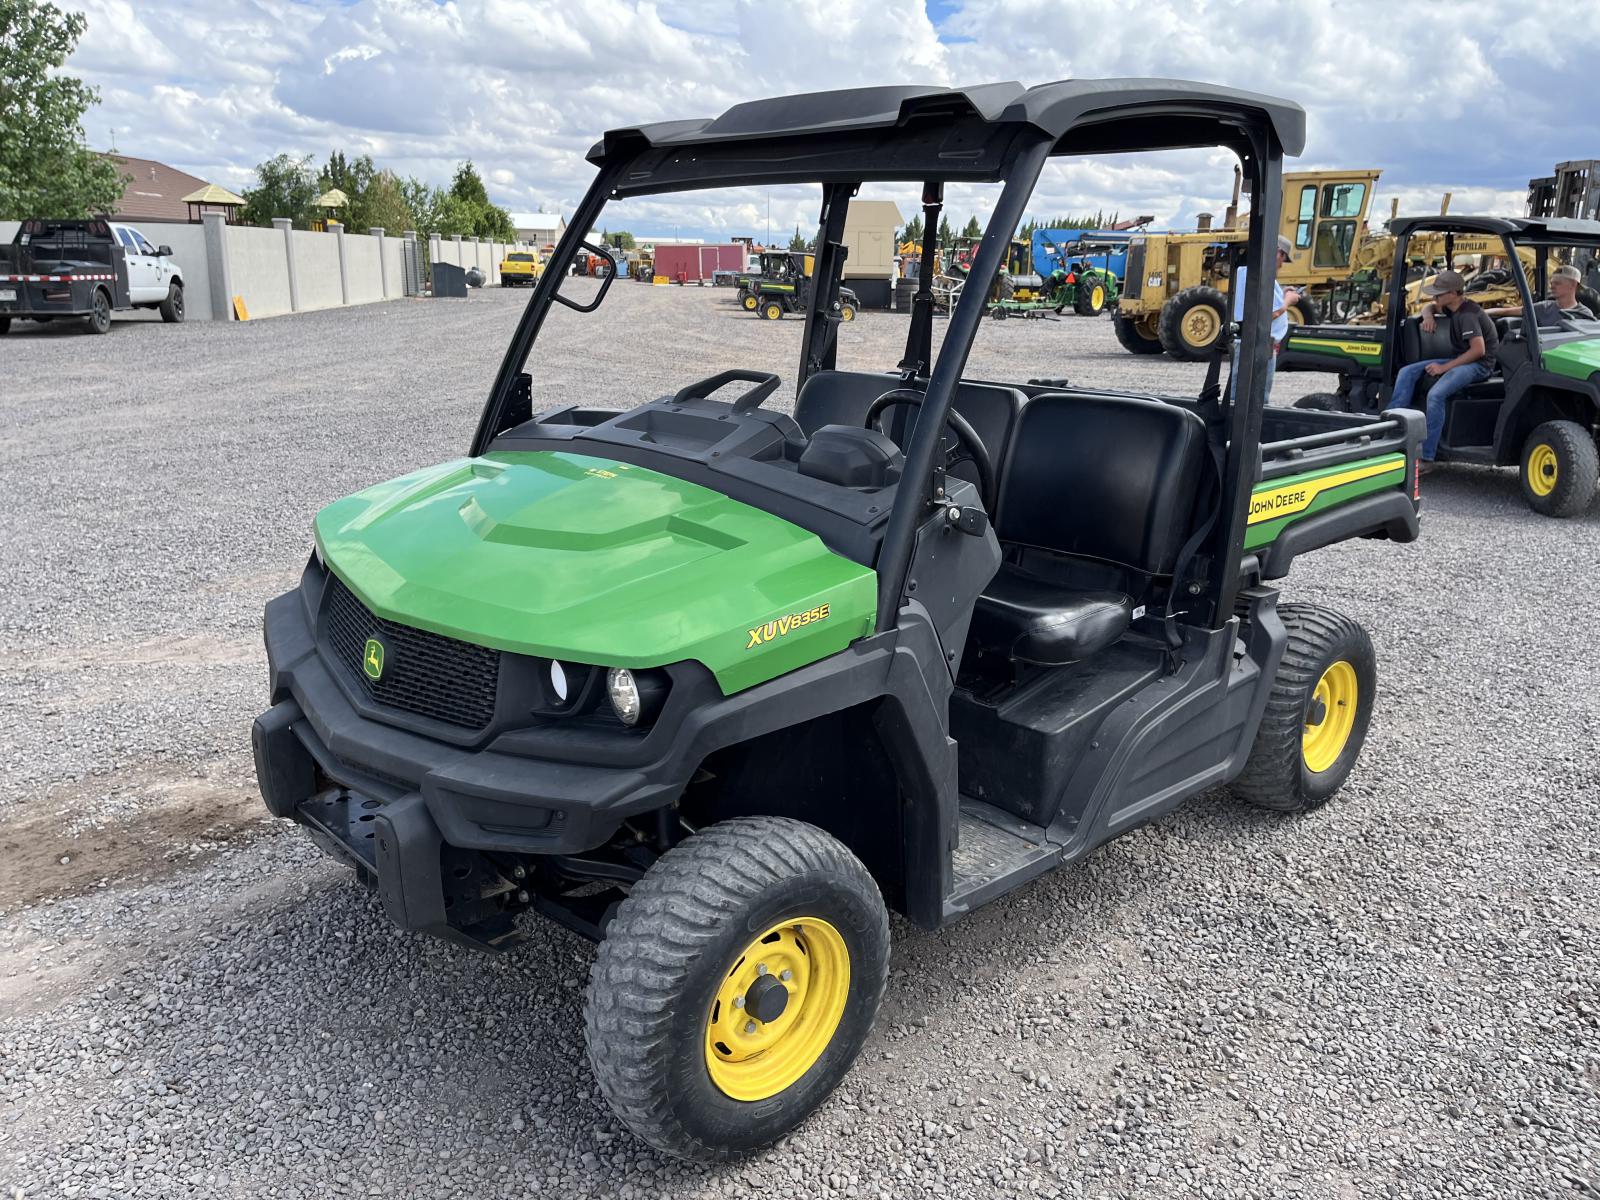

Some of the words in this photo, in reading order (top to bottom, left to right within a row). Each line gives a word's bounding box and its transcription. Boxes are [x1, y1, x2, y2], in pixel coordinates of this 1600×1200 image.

[1453, 242, 1488, 251] TERPILLAR
[1249, 499, 1274, 515] JOHN
[1275, 491, 1306, 508] DEERE
[745, 602, 830, 649] XUV835E
